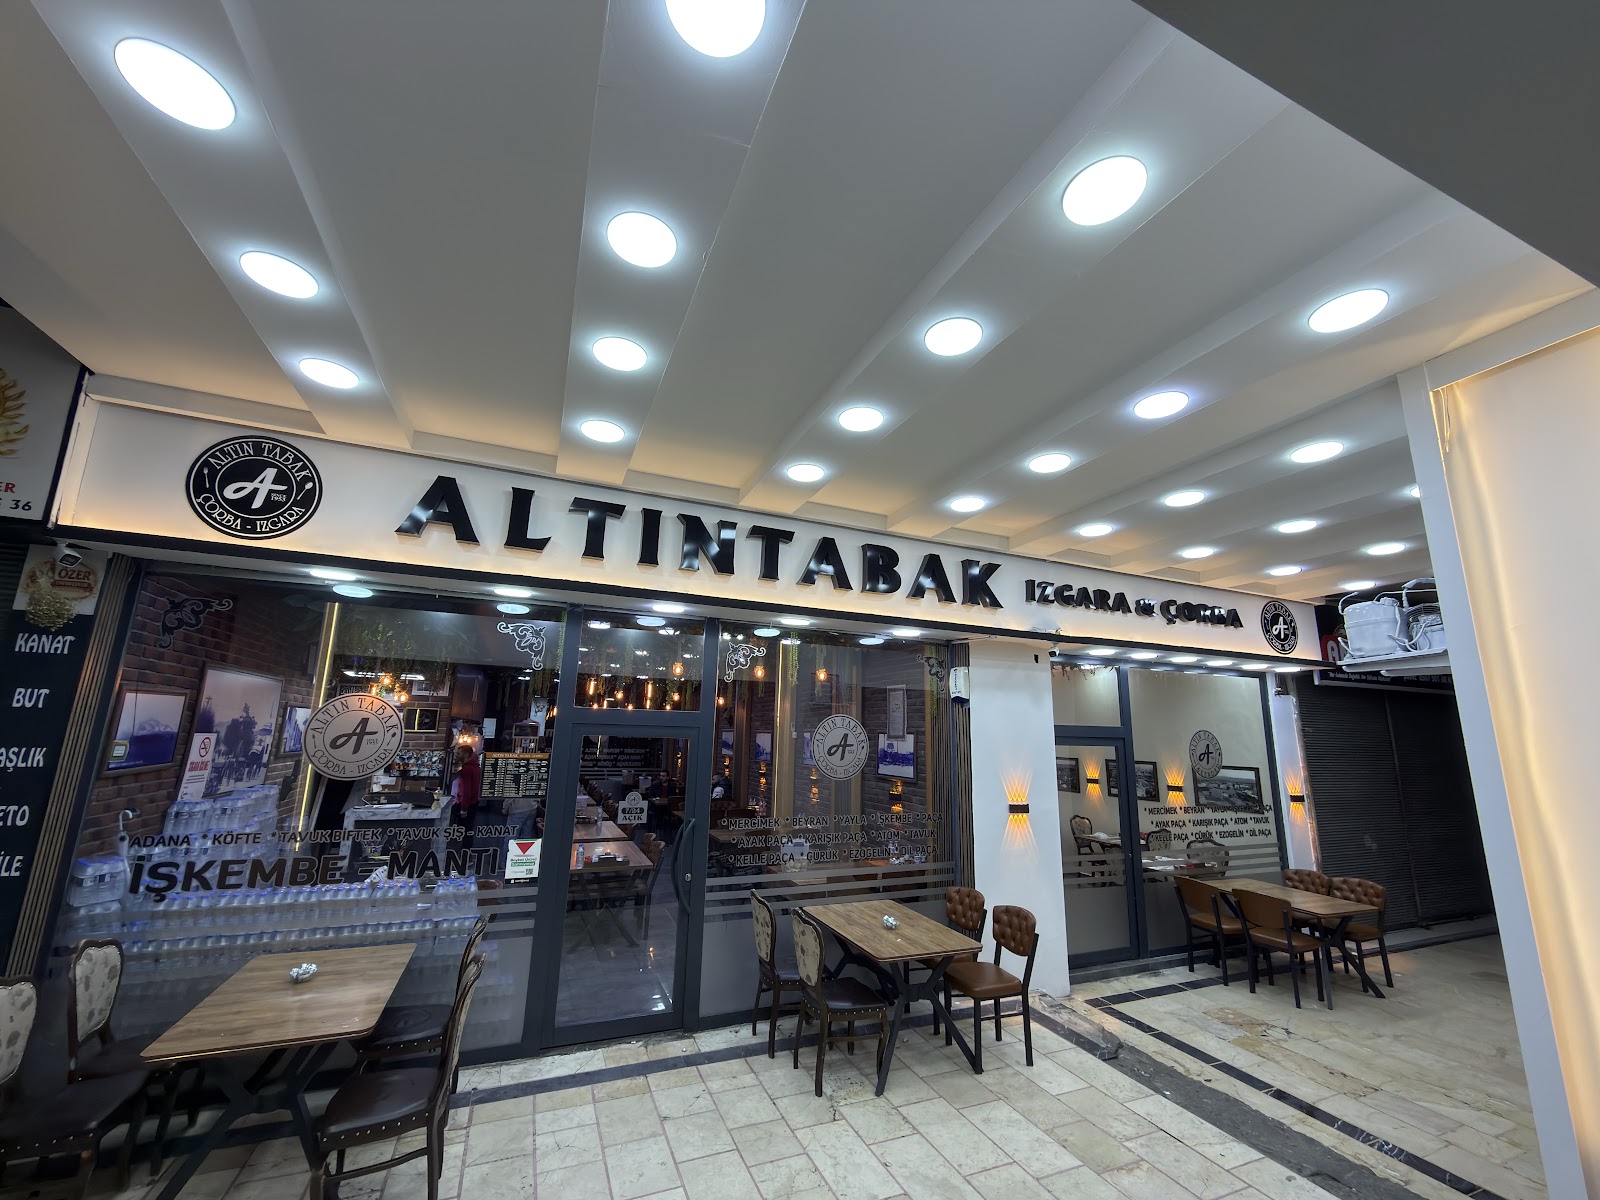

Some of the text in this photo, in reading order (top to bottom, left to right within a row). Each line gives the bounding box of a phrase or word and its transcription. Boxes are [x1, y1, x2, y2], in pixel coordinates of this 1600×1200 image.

[208, 442, 312, 482] ALTIN TABAK
[9, 499, 32, 511] 36
[196, 493, 241, 530] ÇORBA
[256, 506, 306, 532] IZGARA
[394, 475, 1004, 610] ALTINTABAK
[58, 566, 91, 580] ÖZER
[1024, 578, 1133, 614] IZGARA
[1159, 599, 1245, 629] ÇORBA
[15, 632, 76, 655] KANAT
[11, 687, 50, 709] BUT
[310, 697, 399, 735] ALTIN TABAK
[816, 718, 837, 745] ALTIN
[840, 718, 866, 746] TABAK
[310, 749, 346, 775] ÇORBA
[357, 747, 393, 774] IZGARA
[621, 814, 643, 823] AÇIK
[1148, 805, 1178, 815] MERCİMEK
[1183, 806, 1206, 815] BEYRAN
[728, 815, 781, 830] MERCİMEK
[792, 816, 829, 828] BEYRAN
[839, 814, 868, 825] YAYLA
[921, 813, 944, 824] PAÇA
[1155, 816, 1270, 830] AYAK PAÇA KARIŞIK PAÇA ATOM TAVUK
[130, 834, 191, 847] ADANA
[211, 831, 262, 845] KÖFTE
[279, 829, 331, 843] TAVUK
[332, 828, 382, 843] BİFTEK
[395, 826, 442, 840] TAVUK
[443, 824, 466, 843] ŞİŞ
[476, 825, 519, 838] KANAT
[737, 829, 936, 848] AYAK PAÇA KARIŞIK PAÇA ATOM TAVUK
[1173, 832, 1189, 843] PAÇA
[1194, 830, 1214, 840] ÇÜRÜK
[1219, 828, 1244, 839] EZOGELİN
[1249, 827, 1258, 837] DİL
[1258, 828, 1272, 838] PAÇA
[736, 844, 939, 866] KELLE PAÇA ÇÜRÜK EZOGELİN DİL PAÇA
[128, 854, 348, 903] İŞKEMBE
[386, 846, 499, 881] MANTI
